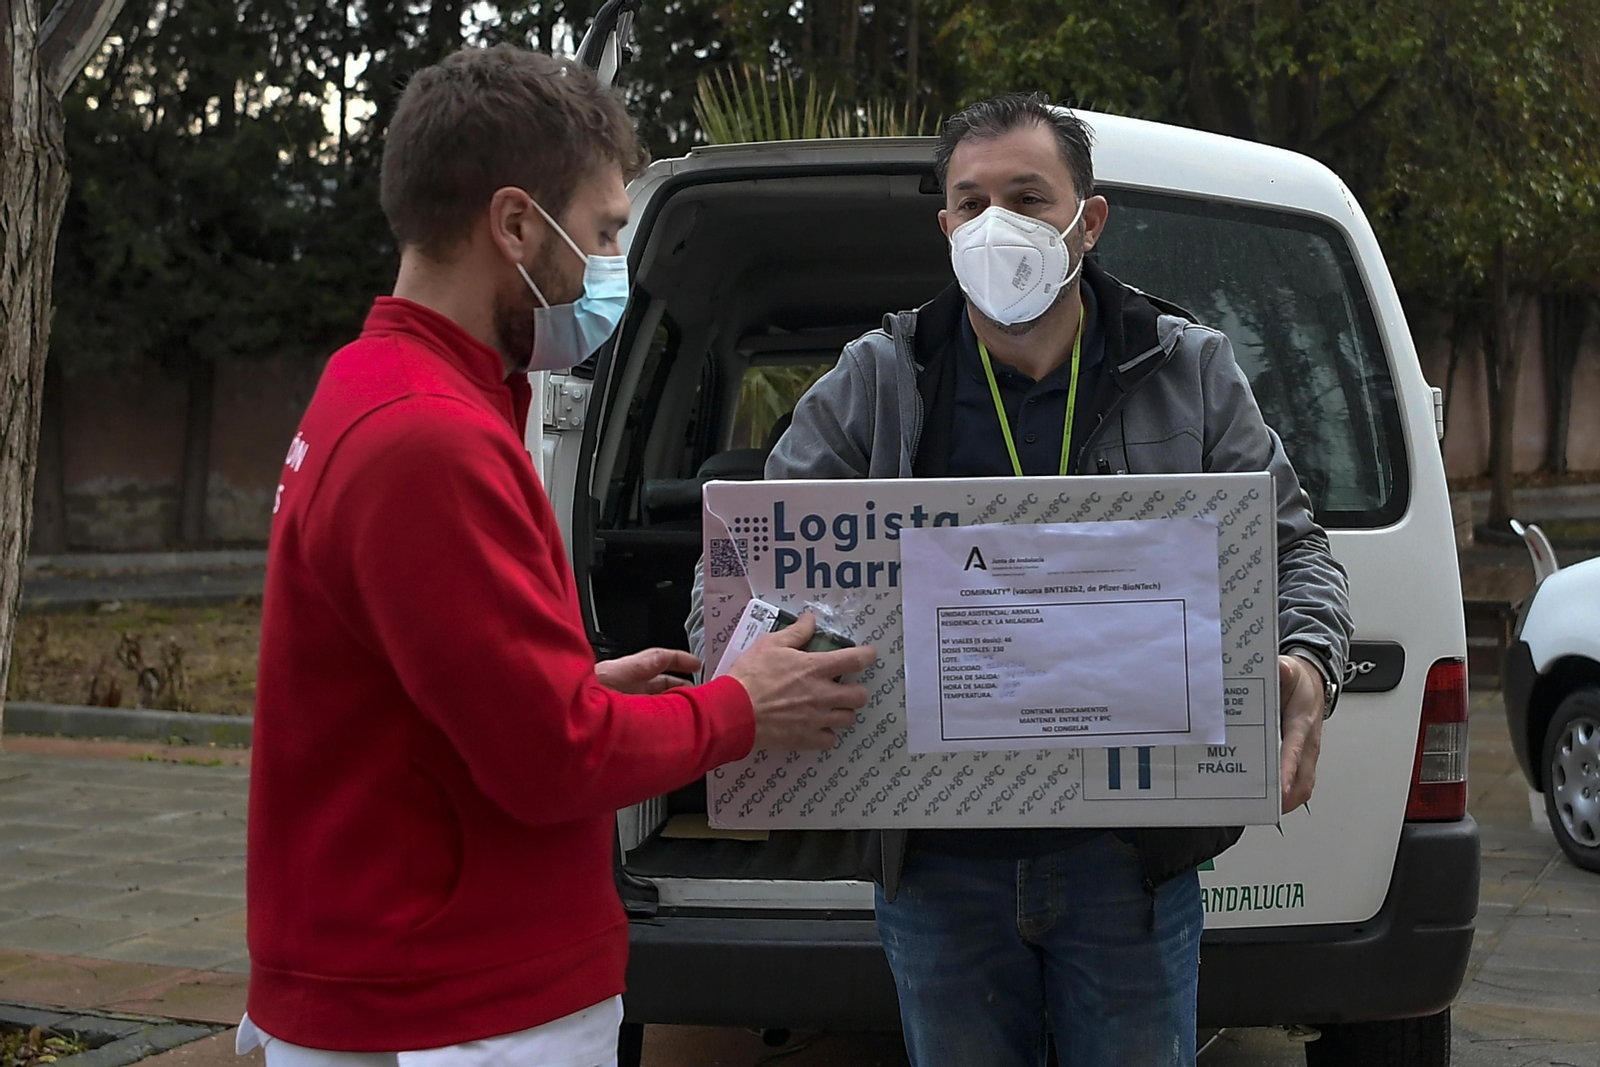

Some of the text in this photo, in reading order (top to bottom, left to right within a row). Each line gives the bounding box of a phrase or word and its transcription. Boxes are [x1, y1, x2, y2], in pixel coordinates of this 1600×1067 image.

[1013, 587, 1042, 596] (vacuna
[1044, 585, 1085, 594] BNT162b2,
[1087, 584, 1097, 592] de
[1099, 581, 1161, 592] Pfizer-BioNTech)
[941, 610, 966, 618] UNIDAD
[942, 664, 982, 672] CADUCIDAD:
[1055, 706, 1108, 714] MEDICAMENTOS
[1207, 746, 1237, 757] MUY
[1198, 760, 1247, 773] FRÁGIL
[1201, 882, 1305, 913] ANDALUCIA
